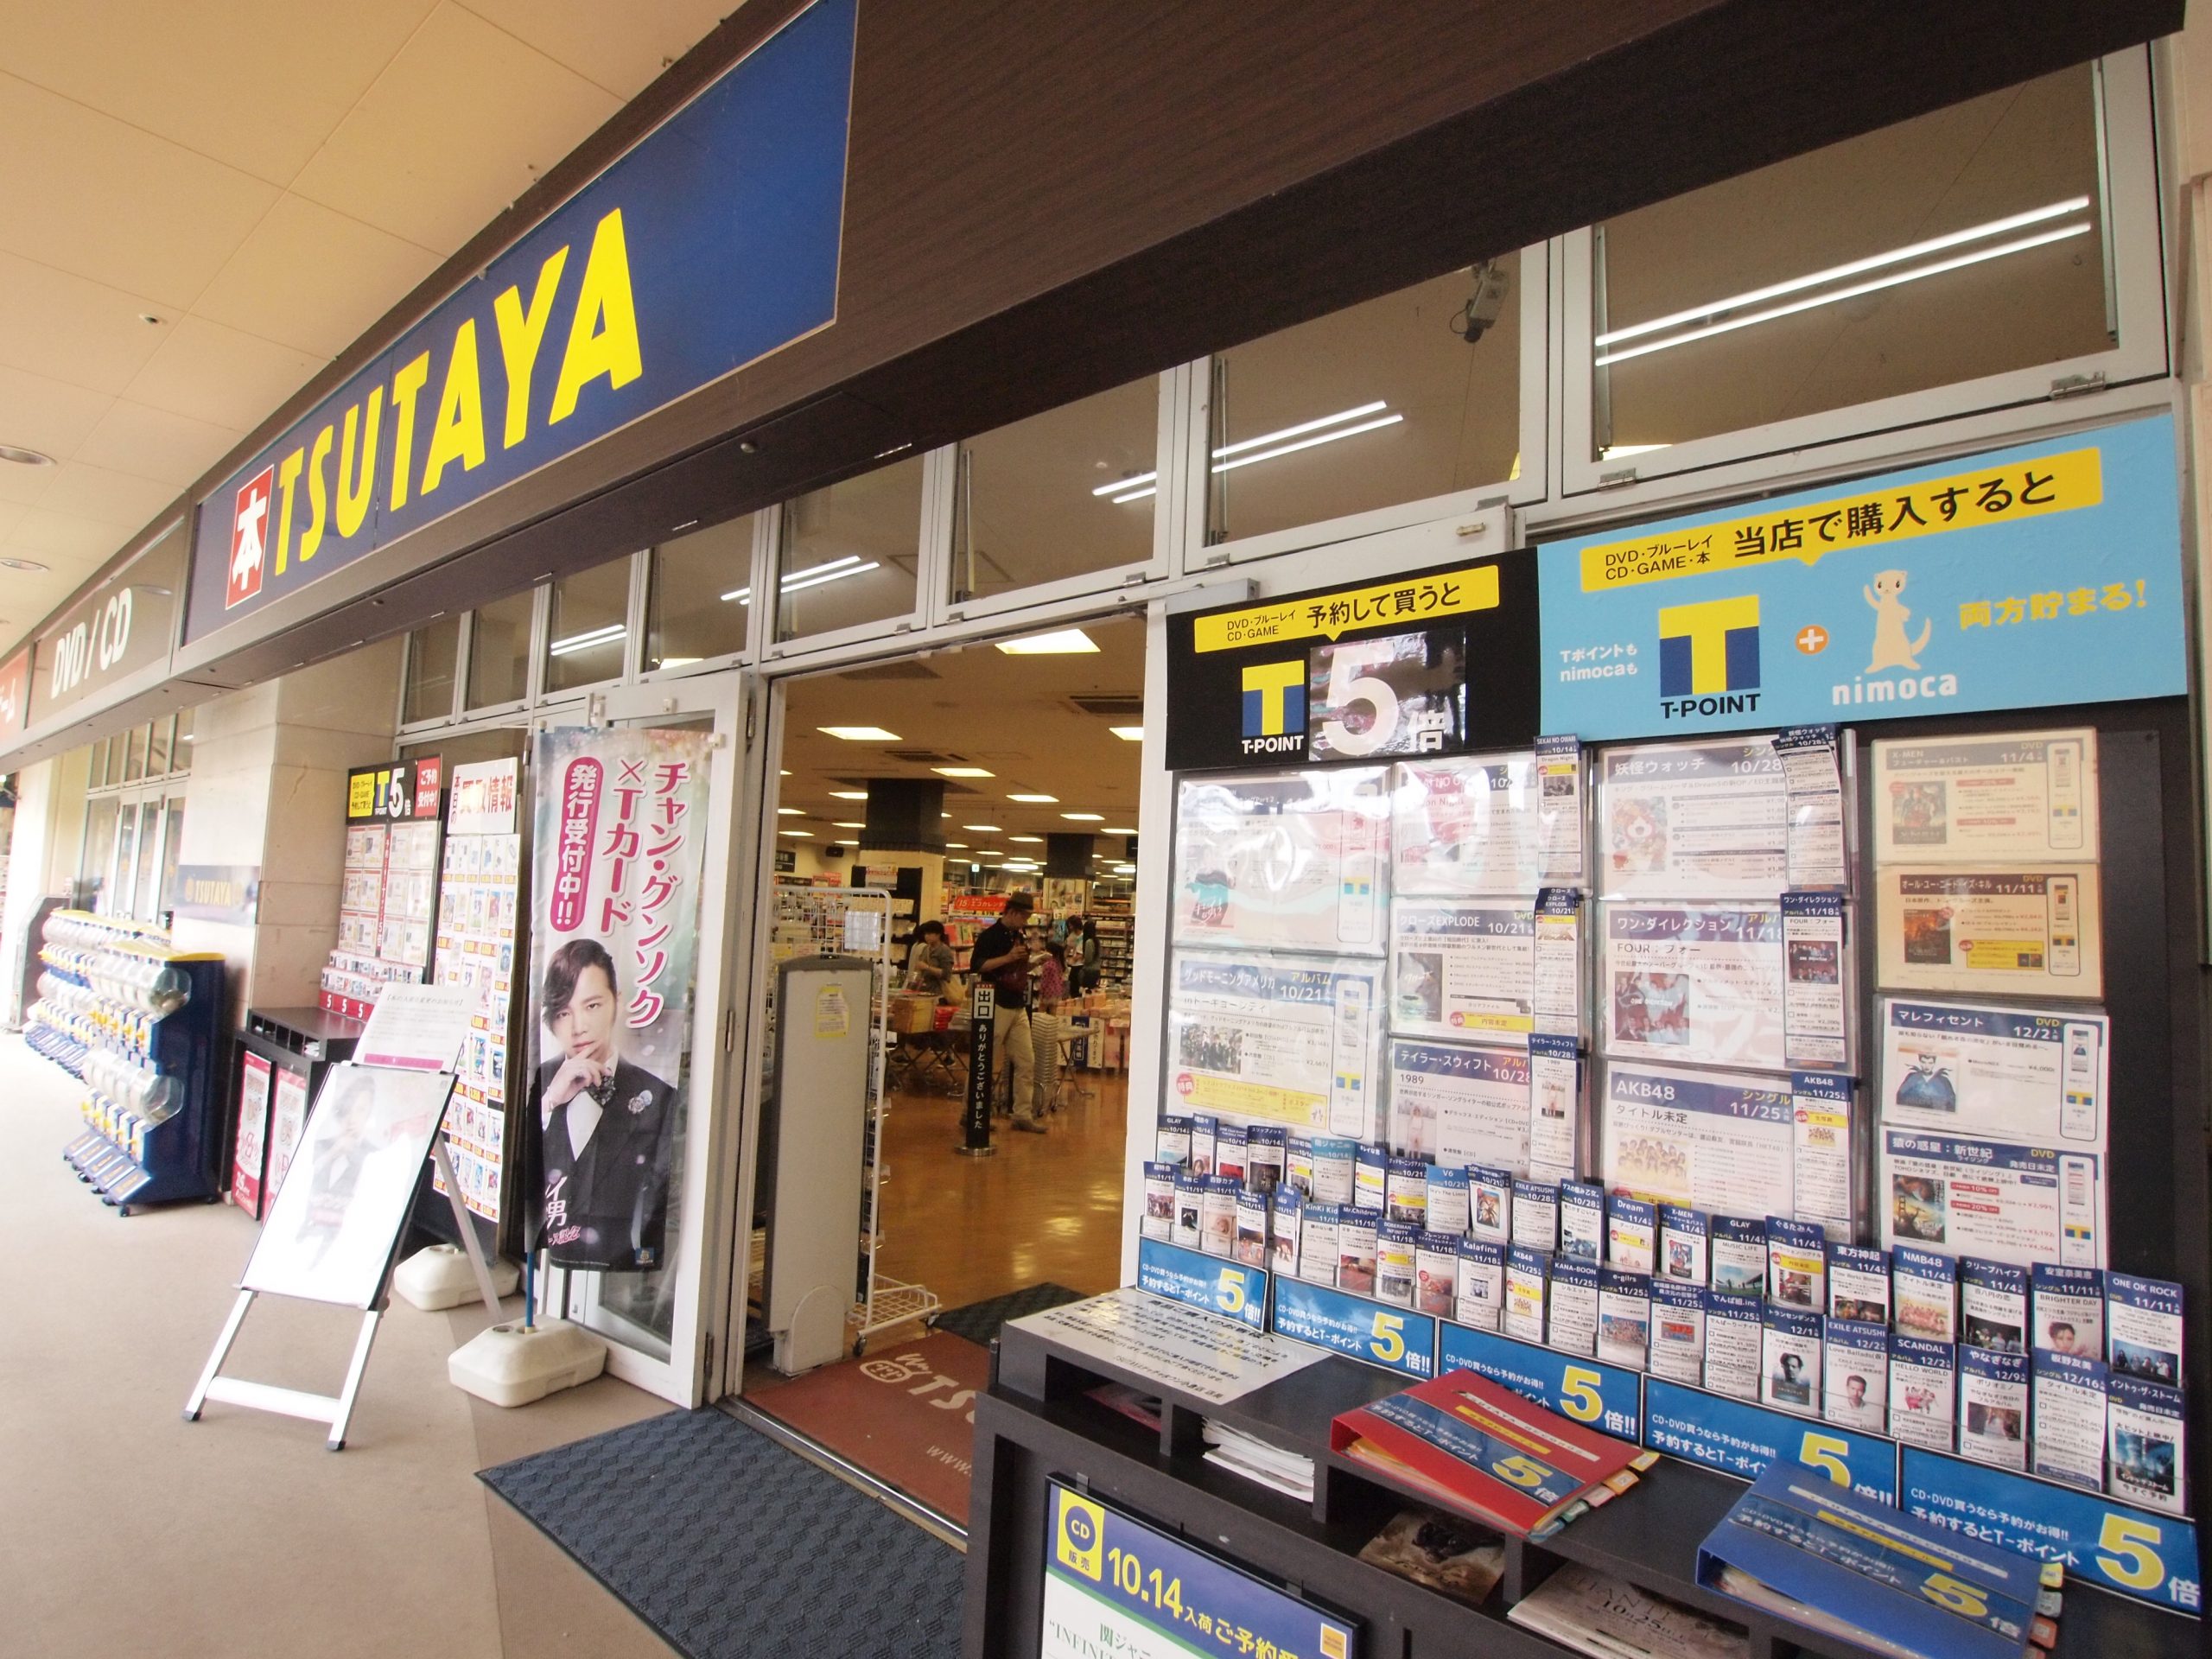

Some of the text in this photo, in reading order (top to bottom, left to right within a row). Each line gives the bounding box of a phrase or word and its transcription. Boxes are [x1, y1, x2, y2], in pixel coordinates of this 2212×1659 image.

[232, 207, 643, 591] 本 TSUTAYA
[1733, 471, 2056, 559] 当店で購入すると
[1605, 534, 1713, 566] DVD・ブルーレイ
[1605, 550, 1711, 581] CD・GAME・本
[1307, 582, 1460, 628] 予約して買うと
[1959, 579, 2147, 632] 両方貯まる!
[1227, 609, 1295, 630] DVD・ブルーレイ
[1227, 626, 1279, 642] CD・GAME
[51, 622, 86, 699] DVD
[100, 588, 131, 671] CD
[1560, 643, 1638, 664] Tポイントも
[1560, 660, 1638, 682] nimocaも
[1832, 672, 1958, 706] nimoca
[1323, 643, 1446, 755] 5 倍
[1661, 693, 1761, 720] T-POINT
[1242, 734, 1304, 754] T-POINT
[2000, 753, 2036, 762] 11/4
[1615, 758, 1706, 776] 妖怪ウォッチ
[1731, 759, 1782, 774] 10/28
[390, 768, 405, 818] 5
[556, 765, 598, 925] 発行受付中!!
[601, 760, 645, 932] ×Tカード
[194, 880, 232, 906] TSUTAYA
[630, 762, 688, 1025] チャン・グンソク
[1996, 884, 2035, 893] 11/11
[1514, 911, 1533, 920] DVD
[1805, 907, 1834, 916] 11/18
[1400, 914, 1480, 927] クローズEXPLODE
[1618, 917, 1730, 931] ワン・ダイレクション
[1488, 924, 1526, 934] 10/21
[1183, 967, 1275, 989] グッドモーニングアメリカ
[1291, 972, 1332, 986] アルバム
[1281, 985, 1321, 1001] 10/21
[327, 995, 332, 1009] 5
[342, 999, 346, 1013] 5
[977, 990, 991, 1017] 出口
[359, 1004, 364, 1017] 5
[1898, 1011, 1984, 1027] マレフィセント
[2036, 1017, 2060, 1027] DVD
[2012, 1026, 2050, 1040] 12/2
[1531, 1037, 1574, 1047] テイラー・スウィフト
[1548, 1050, 1571, 1058] 10/28
[1401, 1051, 1491, 1072] テイラー・スウィフト
[974, 1024, 988, 1129] ありがとうございました
[1400, 1074, 1424, 1084] 1989
[1804, 1076, 1834, 1086] AKB48
[1616, 1079, 1675, 1101] AKB48
[1812, 1090, 1840, 1099] 11/25
[1743, 1090, 1791, 1106] シングル
[1616, 1103, 1688, 1124] タイトル未定
[1731, 1102, 1780, 1120] 11/25
[2031, 1149, 2056, 1159] DVD
[2009, 1160, 2056, 1173] 発売日未定
[1530, 1185, 1554, 1194] ATSUSHI
[1528, 1194, 1551, 1203] 10/28
[1573, 1198, 1596, 1207] 10/28
[1306, 1205, 1324, 1213] KinKi
[1343, 1207, 1377, 1216] Mr.Children
[1618, 1199, 1643, 1213] Dream
[1354, 1219, 1376, 1228] 11/18
[1384, 1222, 1412, 1230] DOBERMAN
[1628, 1215, 1648, 1225] 11/4
[1730, 1219, 1751, 1229] GLAY
[1776, 1220, 1815, 1234] ぐるたみん
[1681, 1224, 1700, 1234] 11/4
[1392, 1235, 1414, 1243] 11/18
[1738, 1233, 1761, 1243] 11/4
[1791, 1237, 1815, 1249] 11/4
[1431, 1245, 1452, 1254] 11/18
[1464, 1241, 1497, 1254] Kalafina
[1837, 1246, 1880, 1262] 東方神起
[1474, 1255, 1497, 1264] 11/18
[1514, 1250, 1534, 1262] AKB48
[1903, 1250, 1942, 1268] NMB48
[1518, 1262, 1538, 1274] 11/25
[1554, 1262, 1596, 1275] KANA-BOON
[1857, 1262, 1881, 1274] 11/4
[1922, 1268, 1946, 1281] 11/4
[1966, 1261, 2021, 1278] クリープハイプ
[1568, 1277, 1592, 1287] 11/25
[1990, 1280, 2017, 1293] 11/4
[2113, 1278, 2177, 1298] ONE OK ROCK
[1216, 1268, 1244, 1313] 5
[1561, 1285, 1587, 1294] シルエット
[1618, 1287, 1643, 1296] 11/25
[2061, 1284, 2094, 1295] 11/11
[1672, 1298, 1698, 1307] 11/25
[1713, 1295, 1757, 1306] でんぱ組.inc
[2040, 1294, 2098, 1306] BRIGHTER DAY
[2134, 1297, 2172, 1313] 11/11
[1278, 1305, 1358, 1335] CD・DVD買うなら予約がお得!!
[1727, 1310, 1755, 1321] 11/25
[1769, 1309, 1816, 1323] トランセンデンス
[1791, 1325, 1814, 1337] 12/1
[1828, 1322, 1885, 1338] EXILE ATSUSHI
[1370, 1312, 1405, 1363] 5
[1406, 1350, 1431, 1374] 倍!!
[1856, 1338, 1880, 1350] 12/2
[1897, 1339, 1945, 1354] SCANDAL
[1920, 1356, 1946, 1368] 12/2
[1969, 1350, 2022, 1368] やなぎなぎ
[2051, 1353, 2093, 1370] 板野友美
[1446, 1353, 1544, 1390] CD・DVD買うなら予約がお得!!
[1895, 1363, 1948, 1376] HELLO WORLD
[1994, 1370, 2020, 1382] 12/9
[2063, 1371, 2100, 1388] 12/16
[2110, 1379, 2181, 1403] イントゥ・ザ・ストーム
[1560, 1365, 1636, 1436] 5 倍!!
[1652, 1414, 1777, 1459] CD・DVD買うなら予約がお得!!
[1799, 1431, 1851, 1488] 5
[1492, 1455, 1554, 1488] 5
[1910, 1488, 2069, 1541] CD・DVD買うなら予約がお得!!
[1071, 1518, 1090, 1540] CD
[1068, 1550, 1090, 1571] 販売
[2096, 1512, 2165, 1591] 5
[2168, 1575, 2201, 1608] 倍
[1108, 1548, 1212, 1635] 10.14 入荷
[1921, 1573, 1989, 1618] 5
